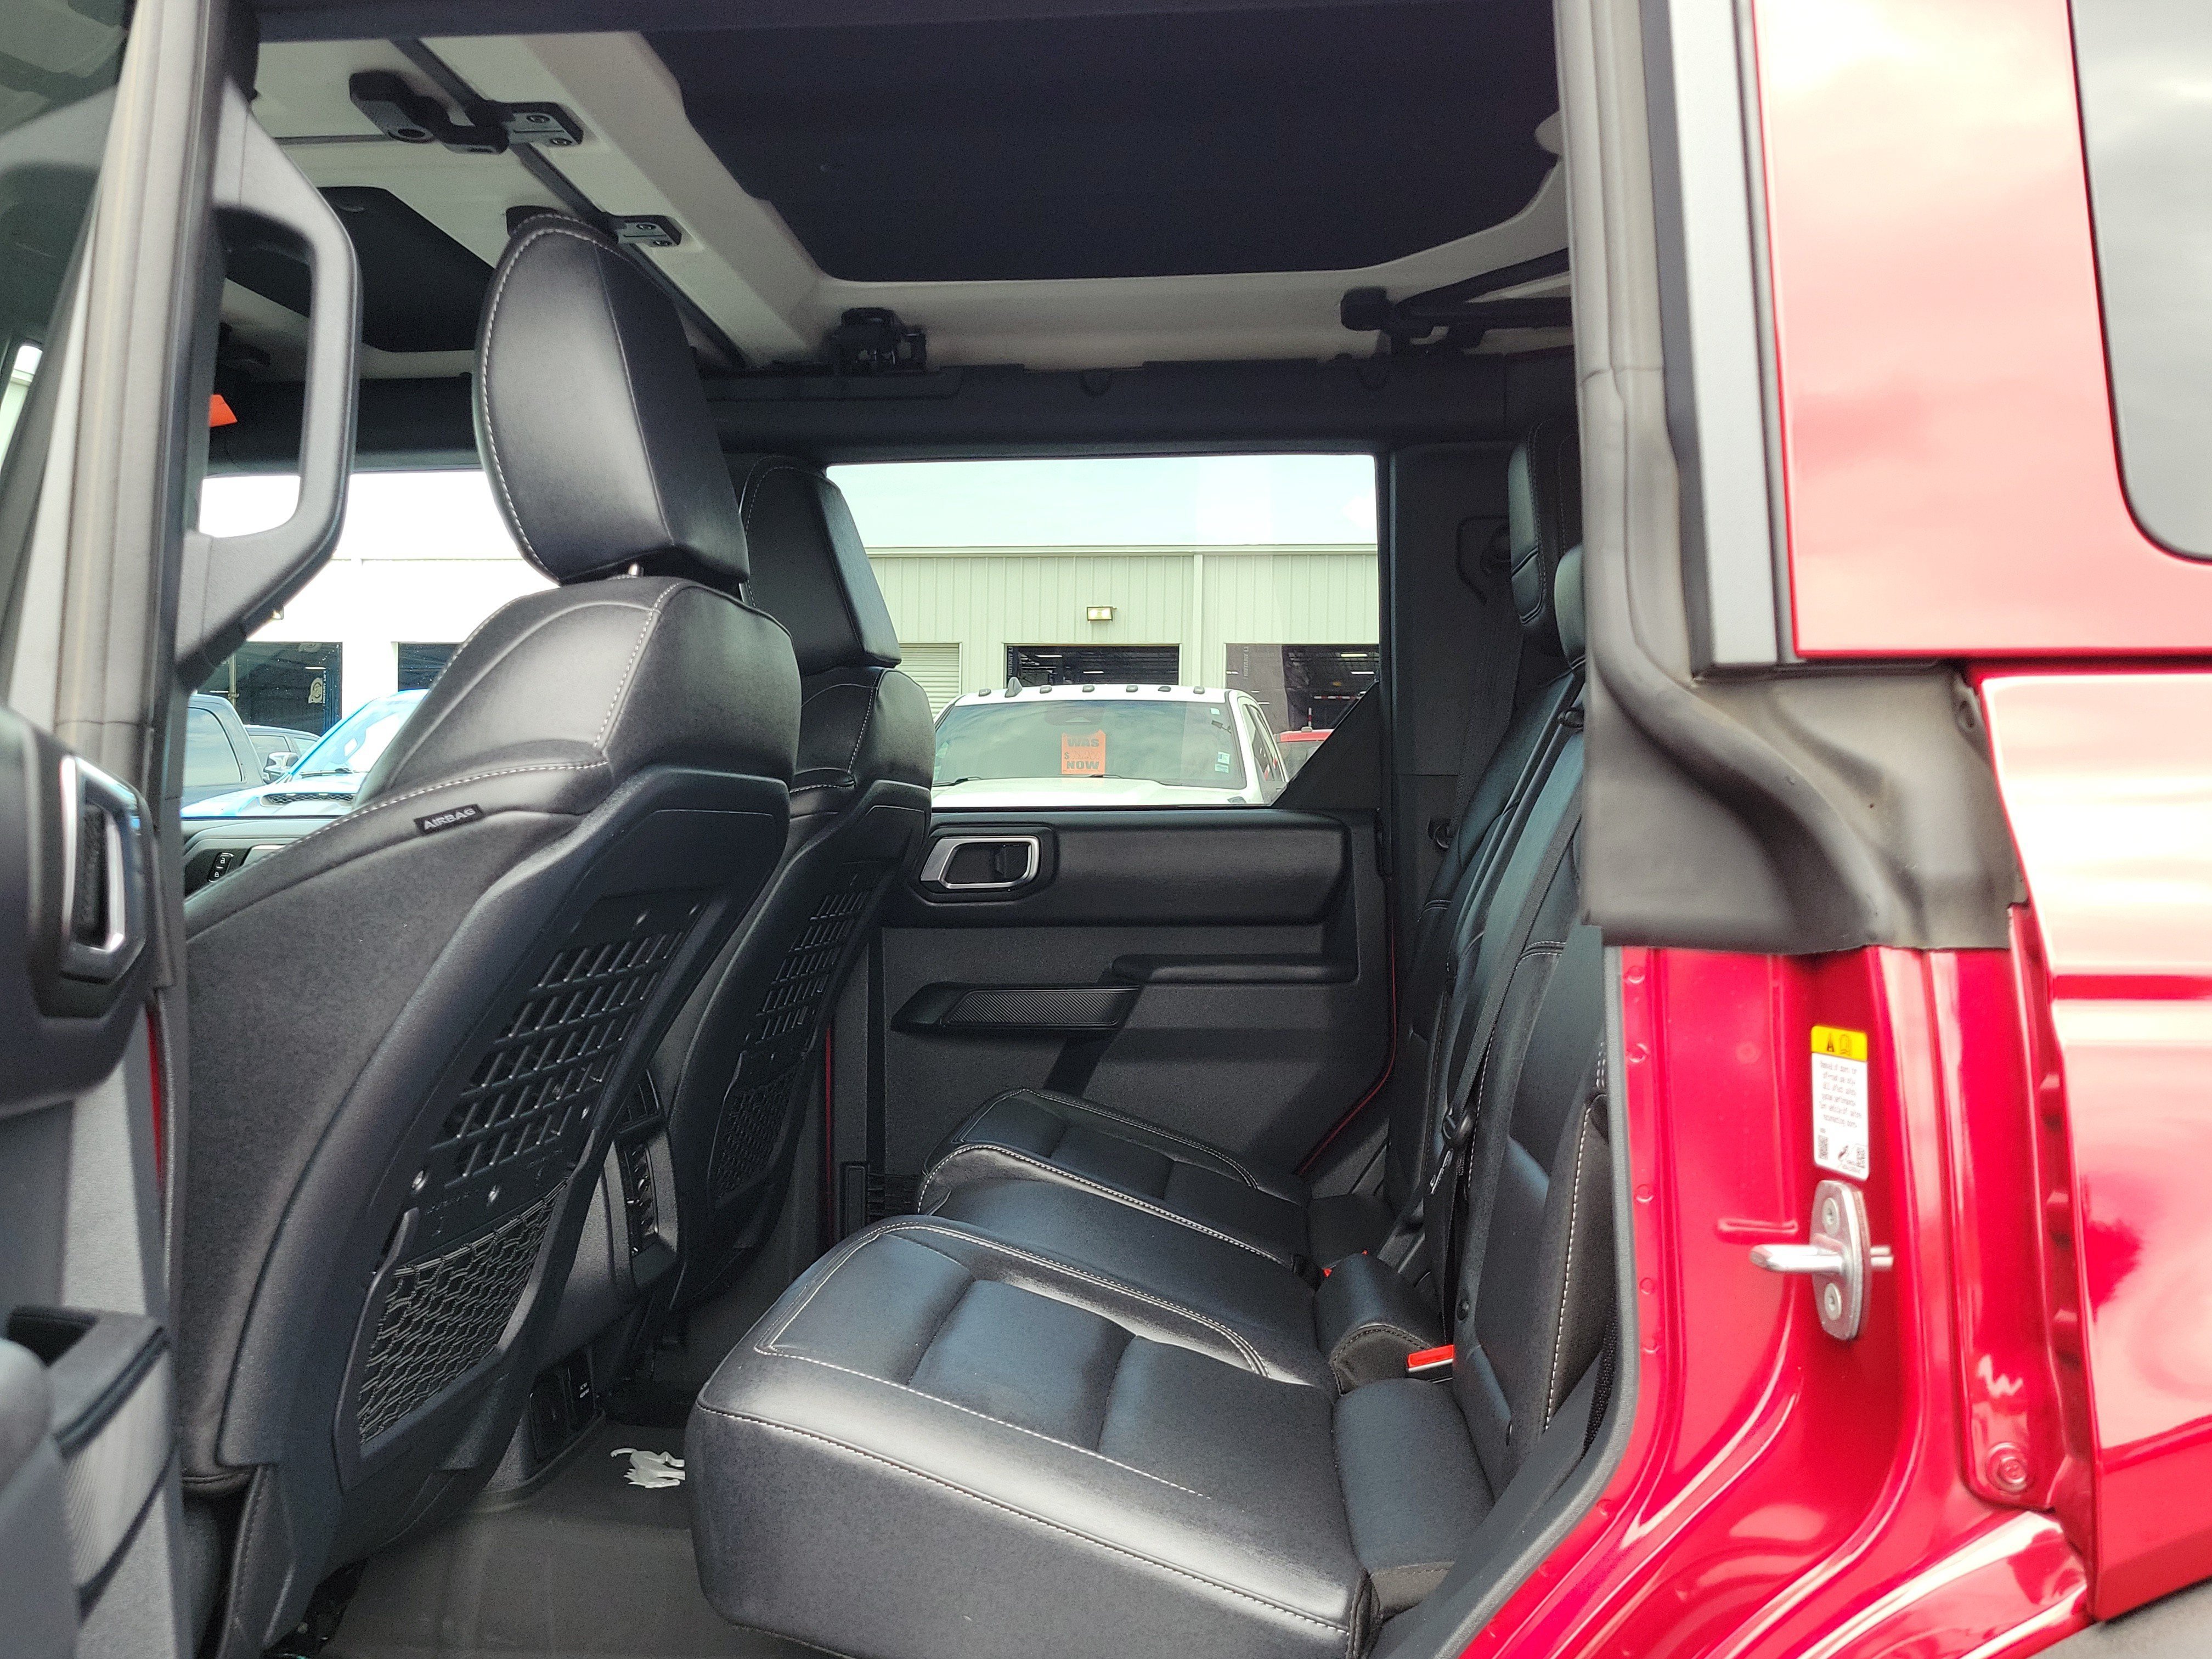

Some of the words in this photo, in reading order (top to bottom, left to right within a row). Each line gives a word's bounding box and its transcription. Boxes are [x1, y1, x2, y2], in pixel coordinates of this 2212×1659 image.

[1067, 738, 1099, 747] WAS
[1066, 760, 1099, 769] NOW
[424, 808, 476, 830] AIRBAG
